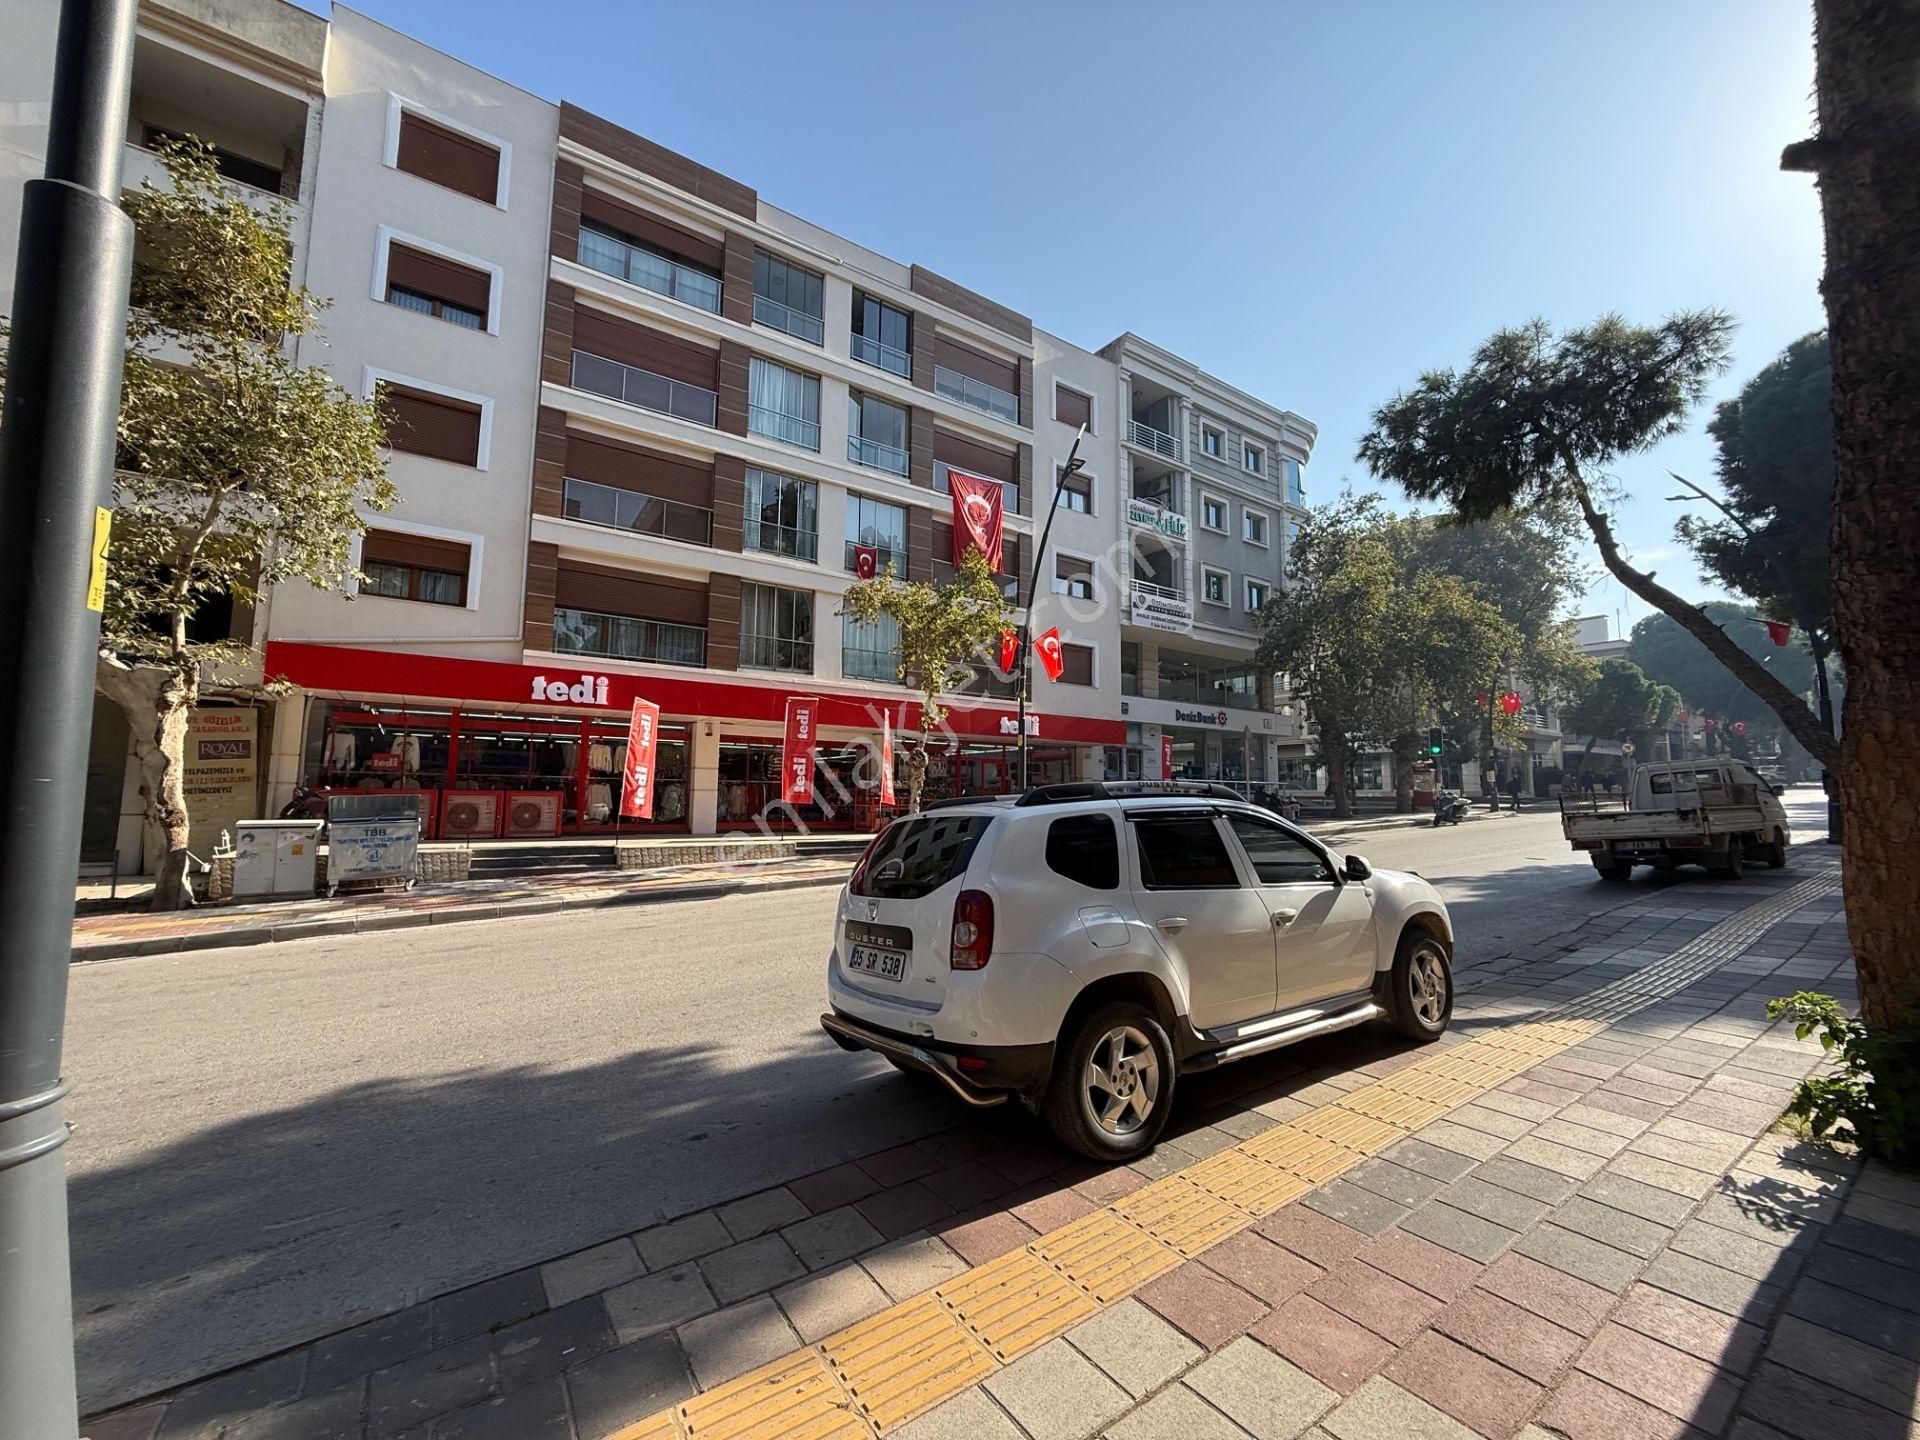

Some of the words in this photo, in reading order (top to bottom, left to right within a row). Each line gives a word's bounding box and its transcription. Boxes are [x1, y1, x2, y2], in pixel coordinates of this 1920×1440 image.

[531, 675, 609, 705] tedi
[796, 708, 809, 739] tedi
[1175, 709, 1217, 725] DenizBank
[640, 713, 652, 749] tedi
[200, 742, 249, 756] ROYAL
[373, 758, 398, 767] tedi
[634, 764, 649, 806] tedi
[793, 757, 806, 793] tedi
[363, 828, 387, 837] TBB
[850, 932, 894, 947] DUSTER
[866, 952, 878, 971] SR
[881, 955, 901, 976] 538
